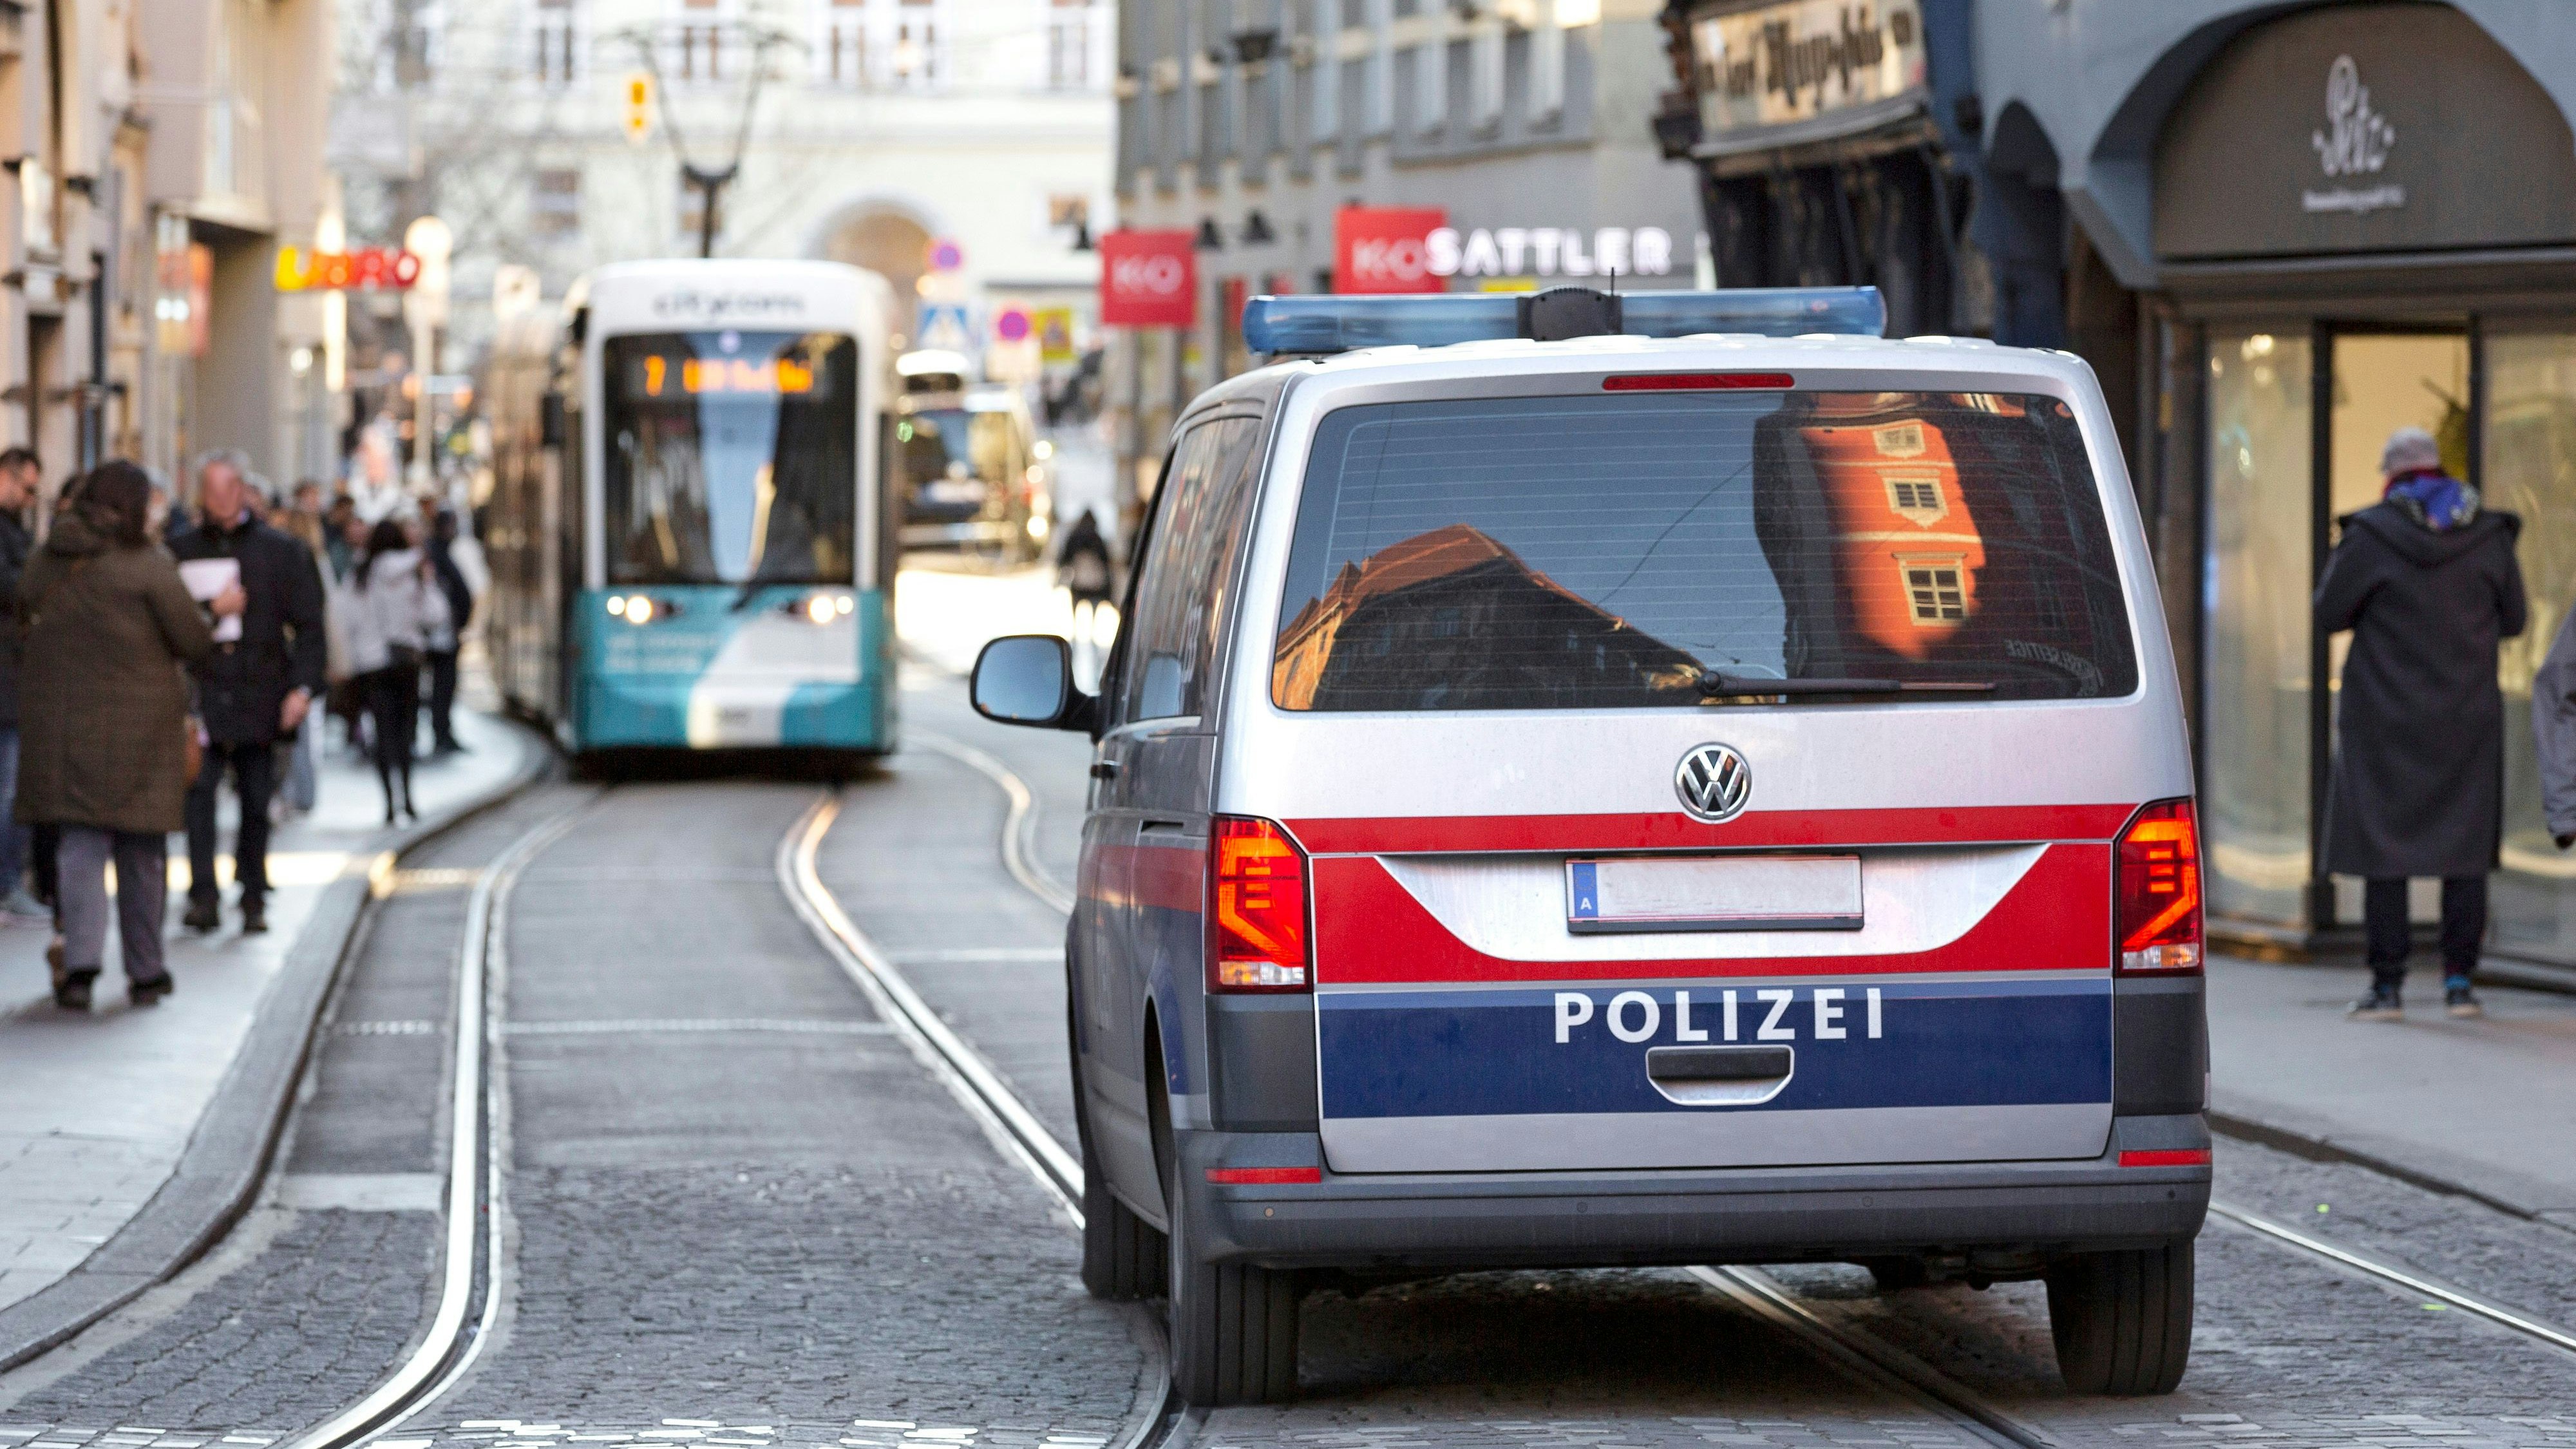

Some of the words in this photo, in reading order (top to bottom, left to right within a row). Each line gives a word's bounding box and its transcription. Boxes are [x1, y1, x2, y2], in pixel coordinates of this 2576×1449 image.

[1425, 227, 1672, 276] SATTLER
[1676, 744, 1749, 819] VW
[1580, 897, 1592, 911] A
[1554, 987, 1882, 1043] POLIZEI
